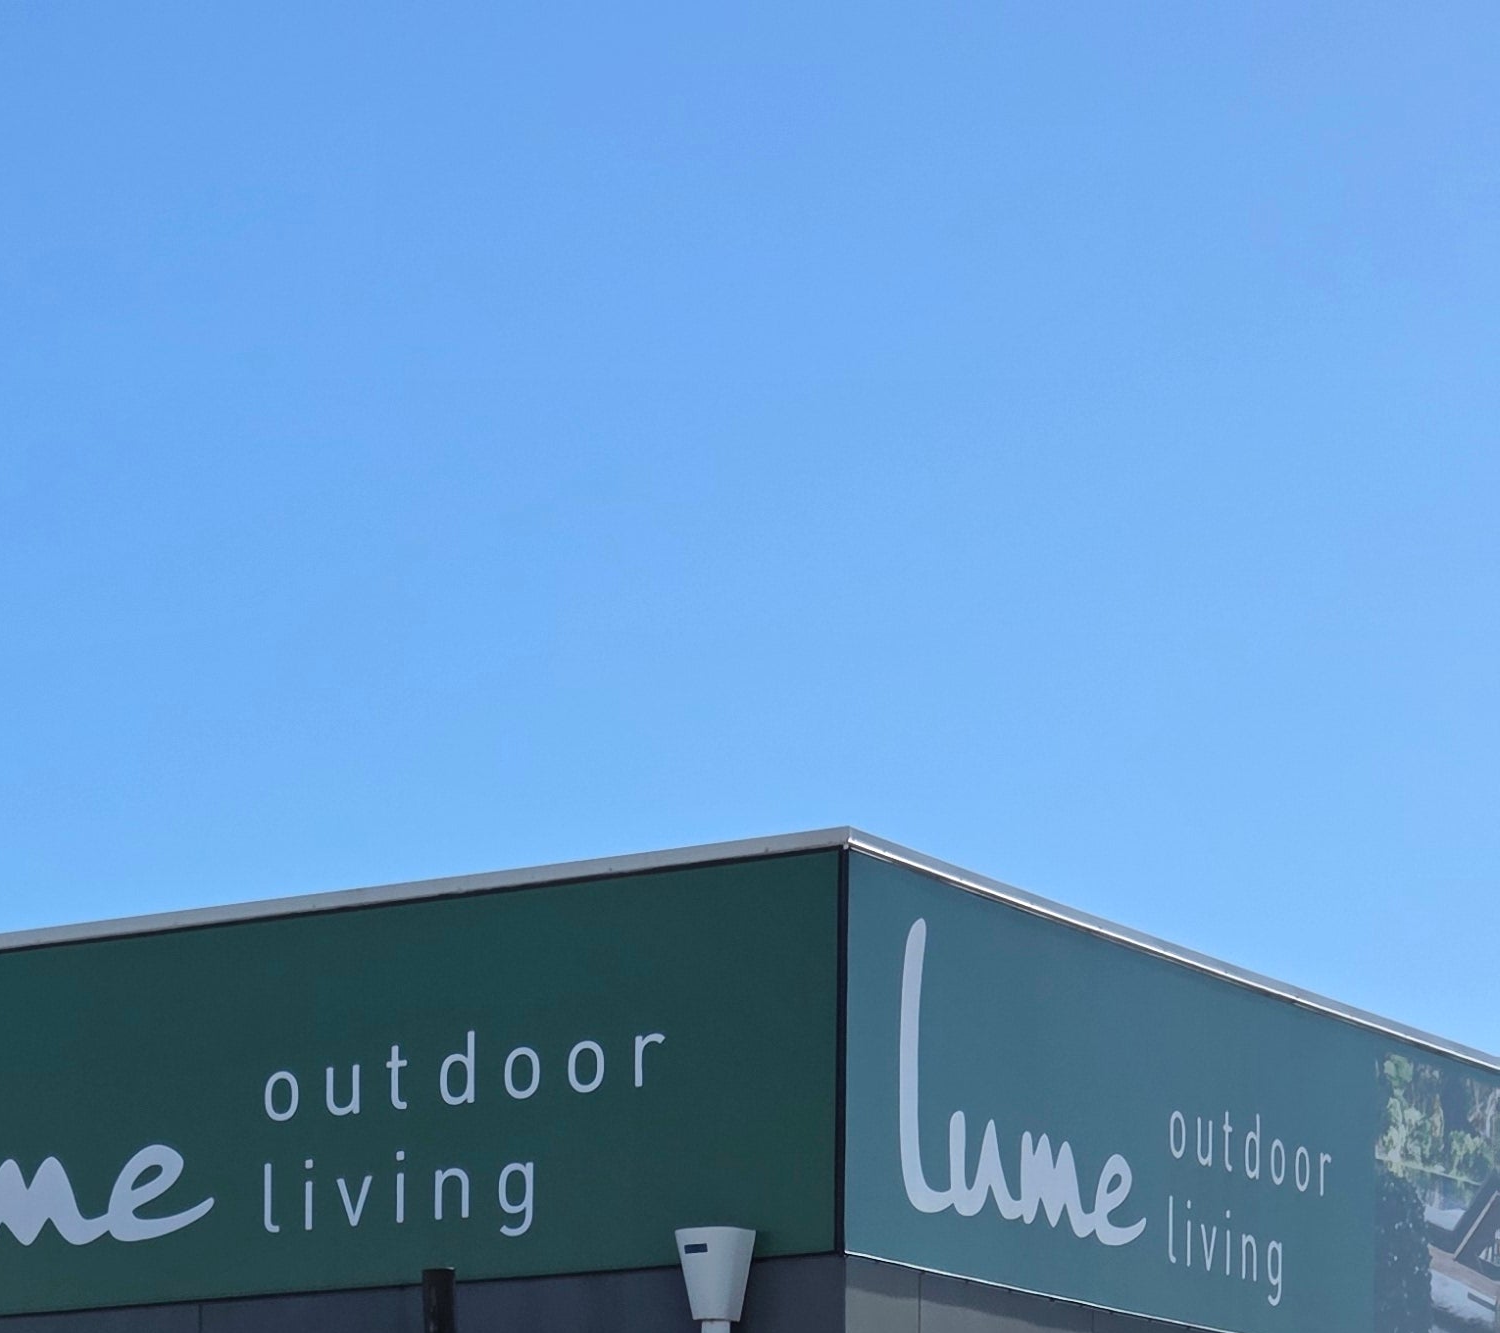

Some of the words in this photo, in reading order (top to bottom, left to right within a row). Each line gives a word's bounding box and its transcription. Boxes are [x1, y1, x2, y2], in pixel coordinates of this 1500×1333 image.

[263, 1030, 665, 1122] outdoor
[263, 1151, 535, 1236] living
[1169, 1110, 1332, 1197] outdoor
[1167, 1195, 1284, 1307] living
